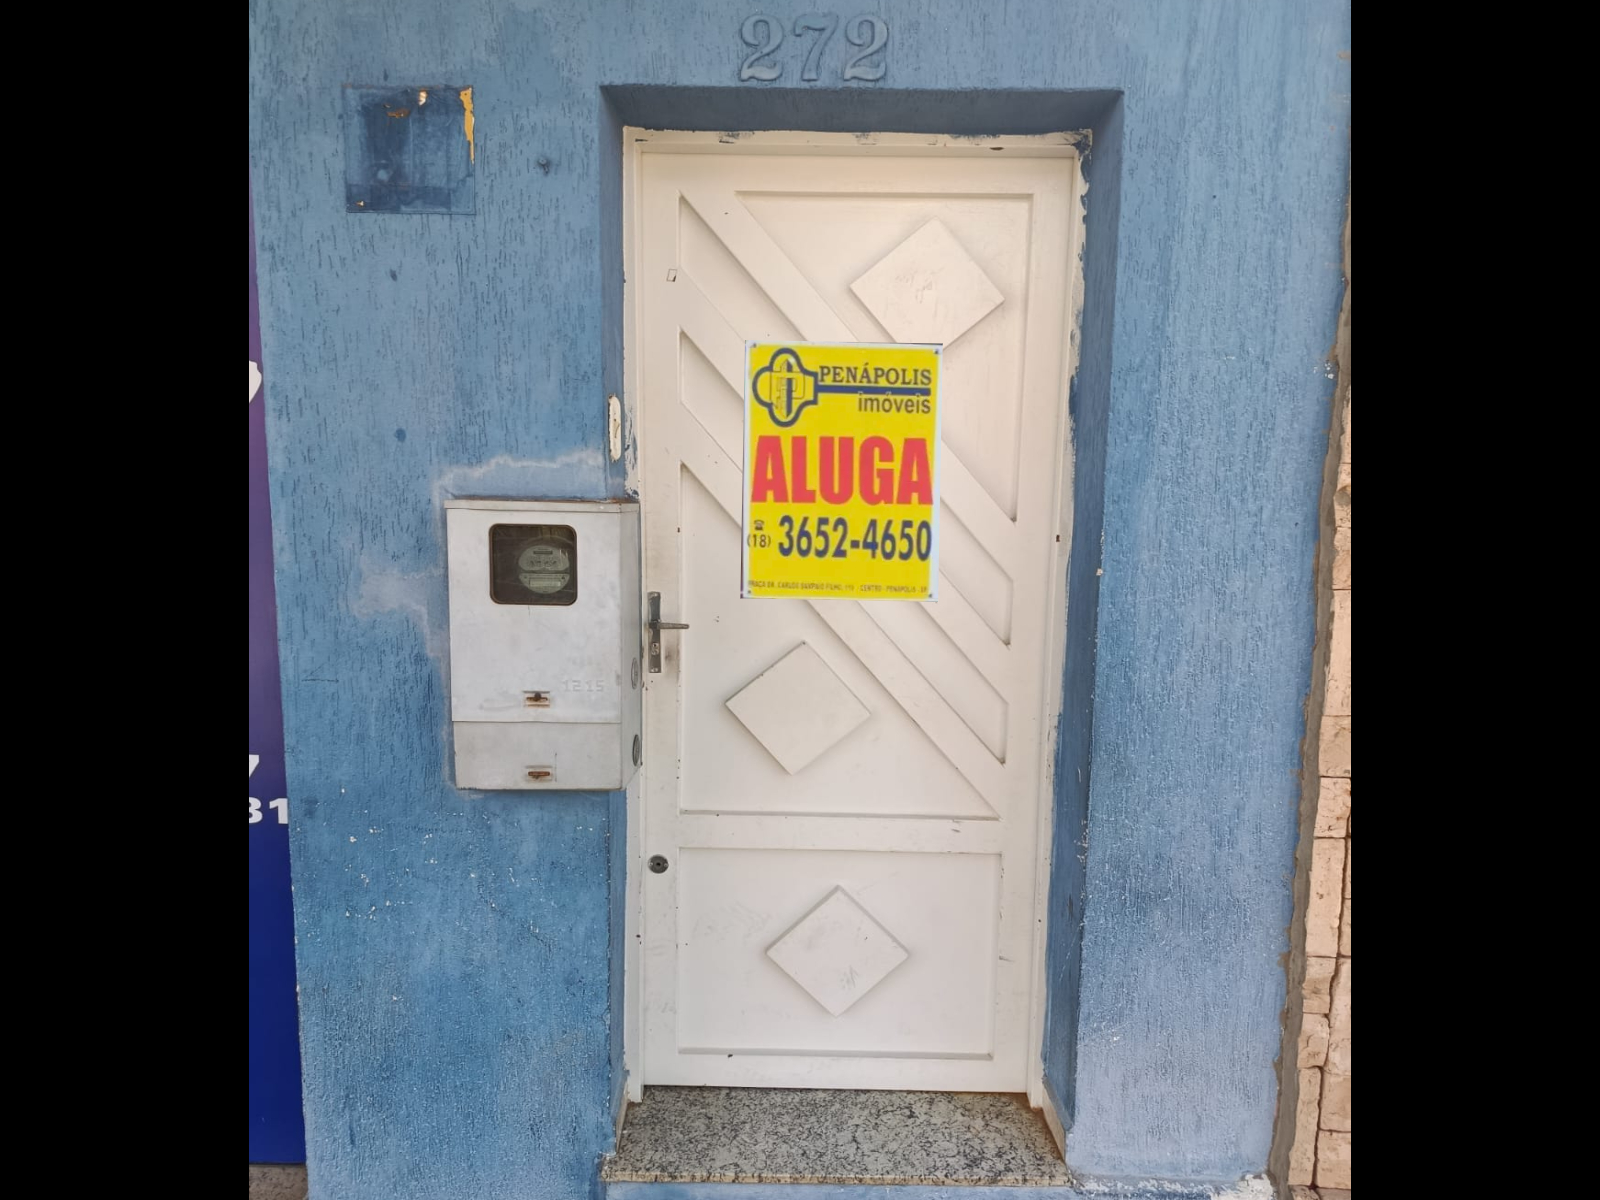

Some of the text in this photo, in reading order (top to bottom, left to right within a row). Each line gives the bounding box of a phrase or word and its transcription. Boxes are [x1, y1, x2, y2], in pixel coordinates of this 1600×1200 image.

[739, 13, 890, 82] 272
[818, 363, 932, 386] PENÁPOLIS
[857, 391, 931, 414] imóveis
[751, 435, 934, 506] ALUGA
[747, 515, 932, 562] (18) 3652-4650
